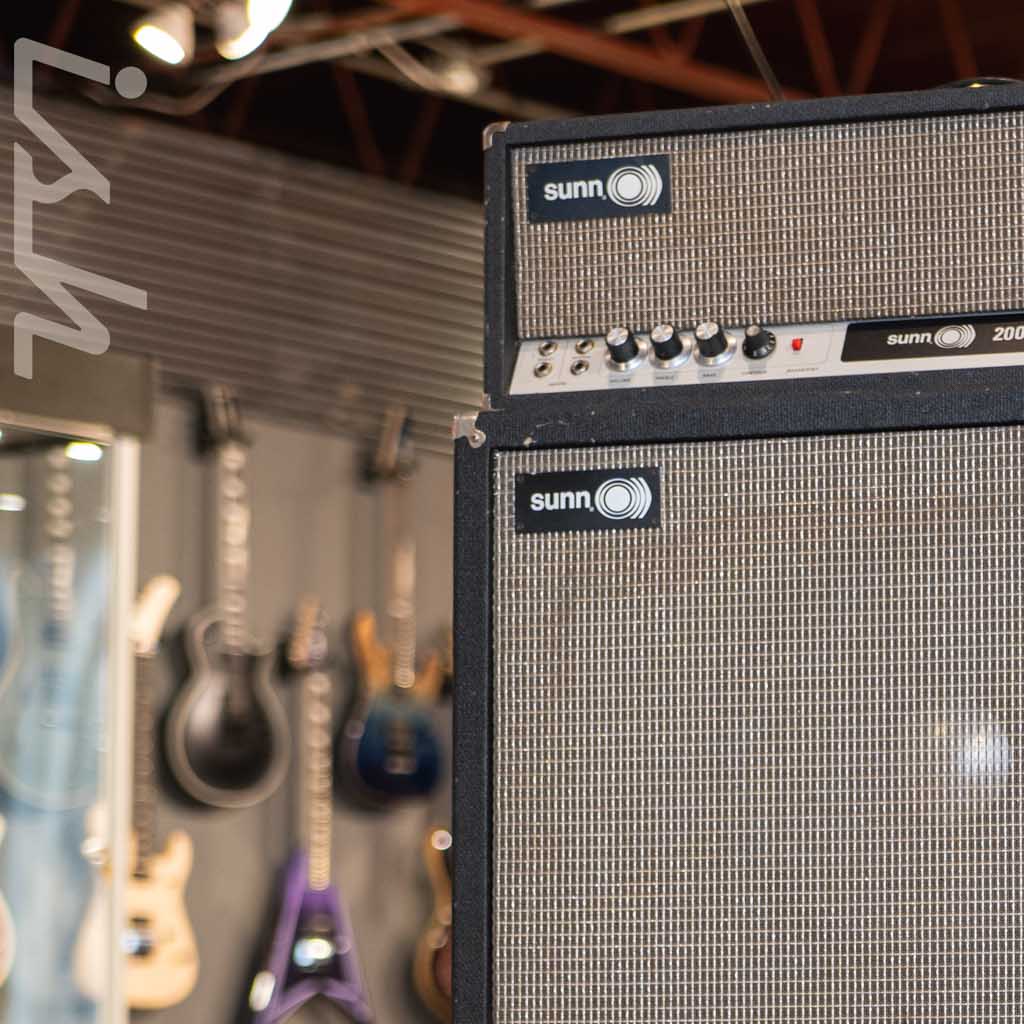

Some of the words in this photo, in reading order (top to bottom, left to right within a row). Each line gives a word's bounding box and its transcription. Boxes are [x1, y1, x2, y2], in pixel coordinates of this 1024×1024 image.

[543, 178, 604, 201] sunn
[886, 332, 932, 345] sunn
[529, 490, 591, 512] sunn
